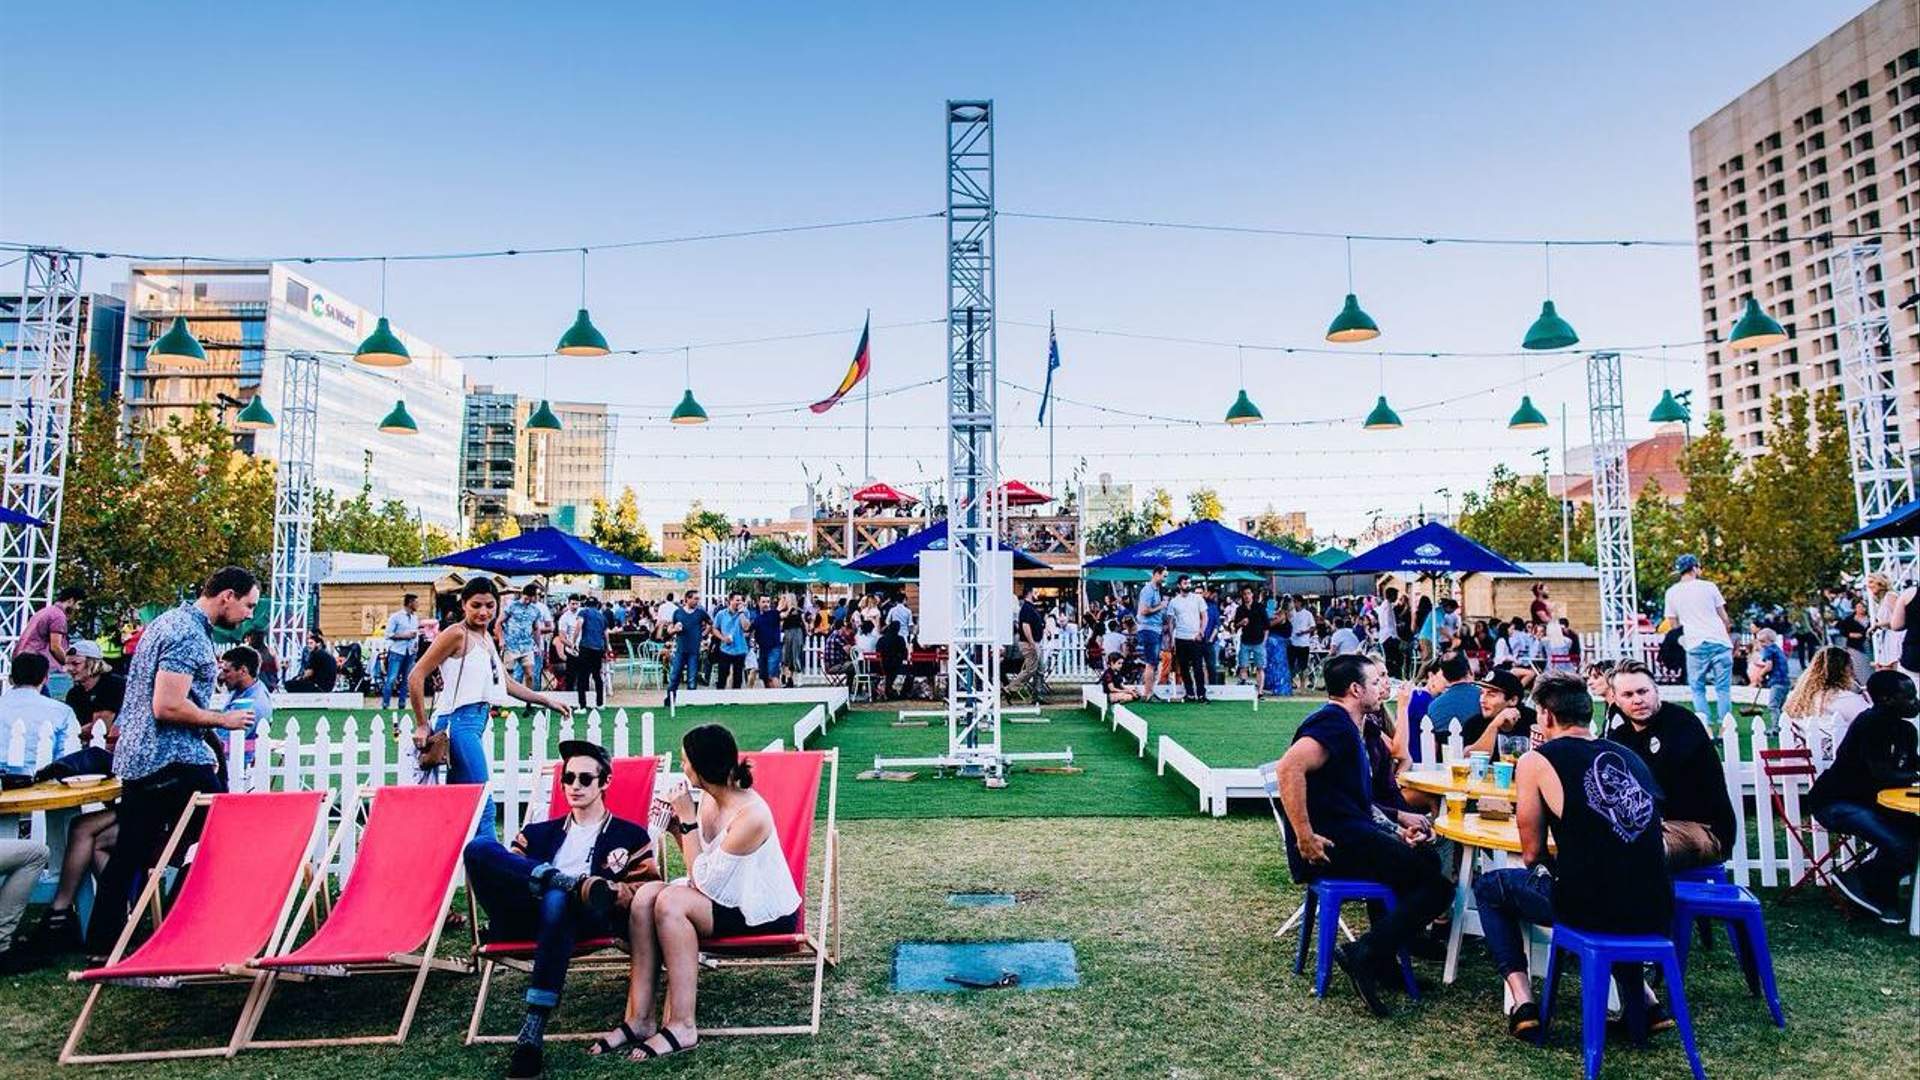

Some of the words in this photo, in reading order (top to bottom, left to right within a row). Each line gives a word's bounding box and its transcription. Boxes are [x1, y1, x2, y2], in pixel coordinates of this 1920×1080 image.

[325, 303, 335, 320] SA
[335, 308, 356, 329] Water
[1419, 558, 1451, 566] ROGER
